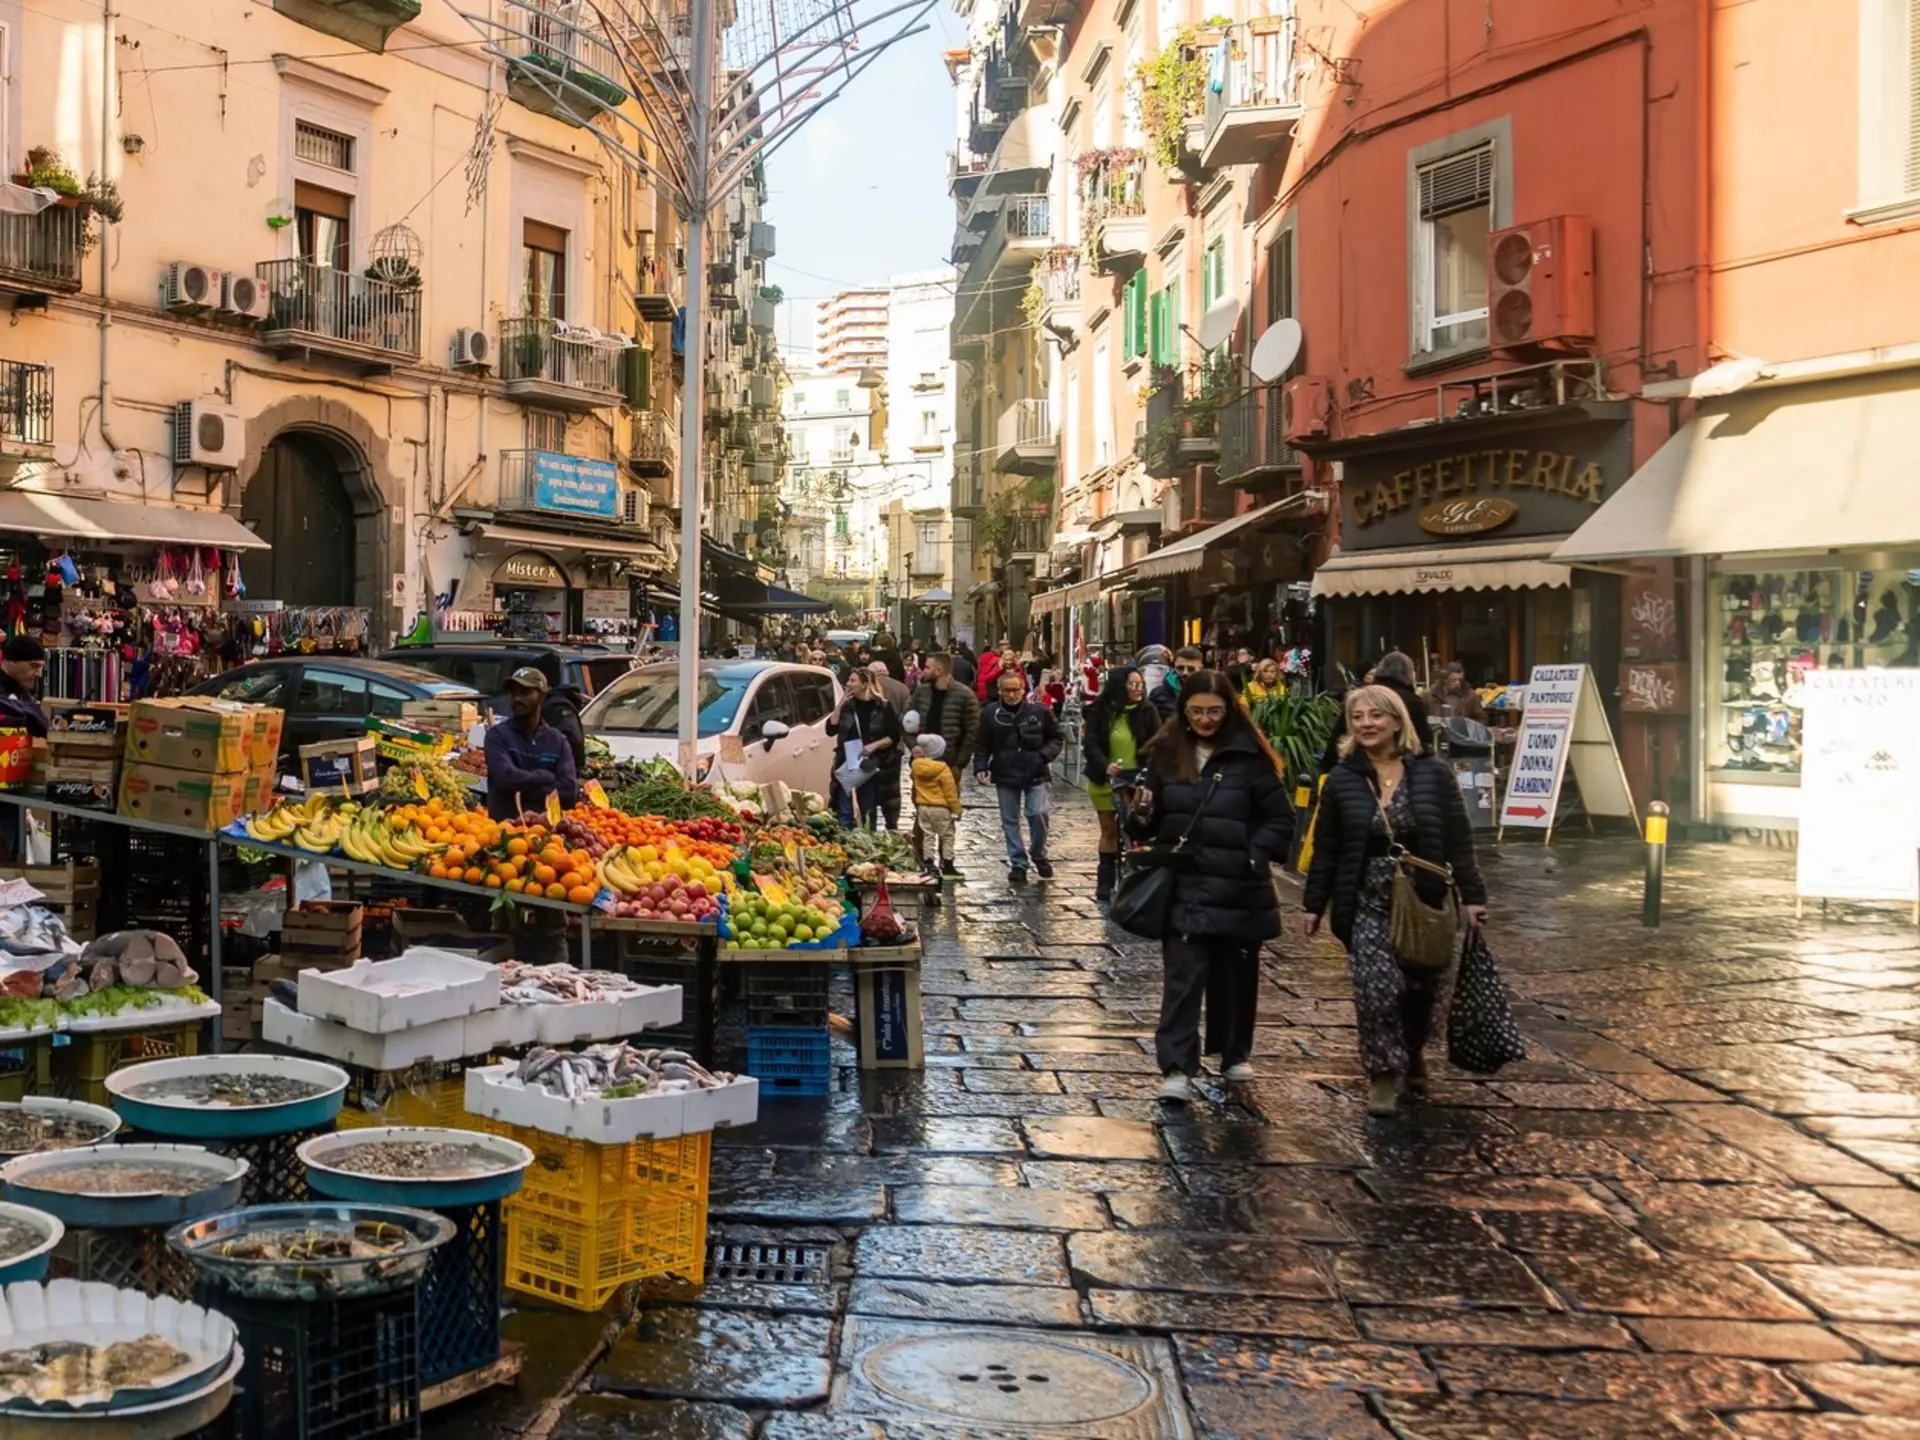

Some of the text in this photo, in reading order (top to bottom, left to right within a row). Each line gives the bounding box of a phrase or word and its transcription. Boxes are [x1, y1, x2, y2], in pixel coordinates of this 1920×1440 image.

[1352, 449, 1604, 529] CAFFETTERIA
[505, 561, 557, 578] Mister X
[1534, 669, 1580, 681] CALZATURE
[1529, 692, 1574, 704] PANTOFOLE
[1527, 734, 1557, 750] UOMO
[1520, 755, 1553, 772] DONNA
[1513, 777, 1552, 793] BAMBINO
